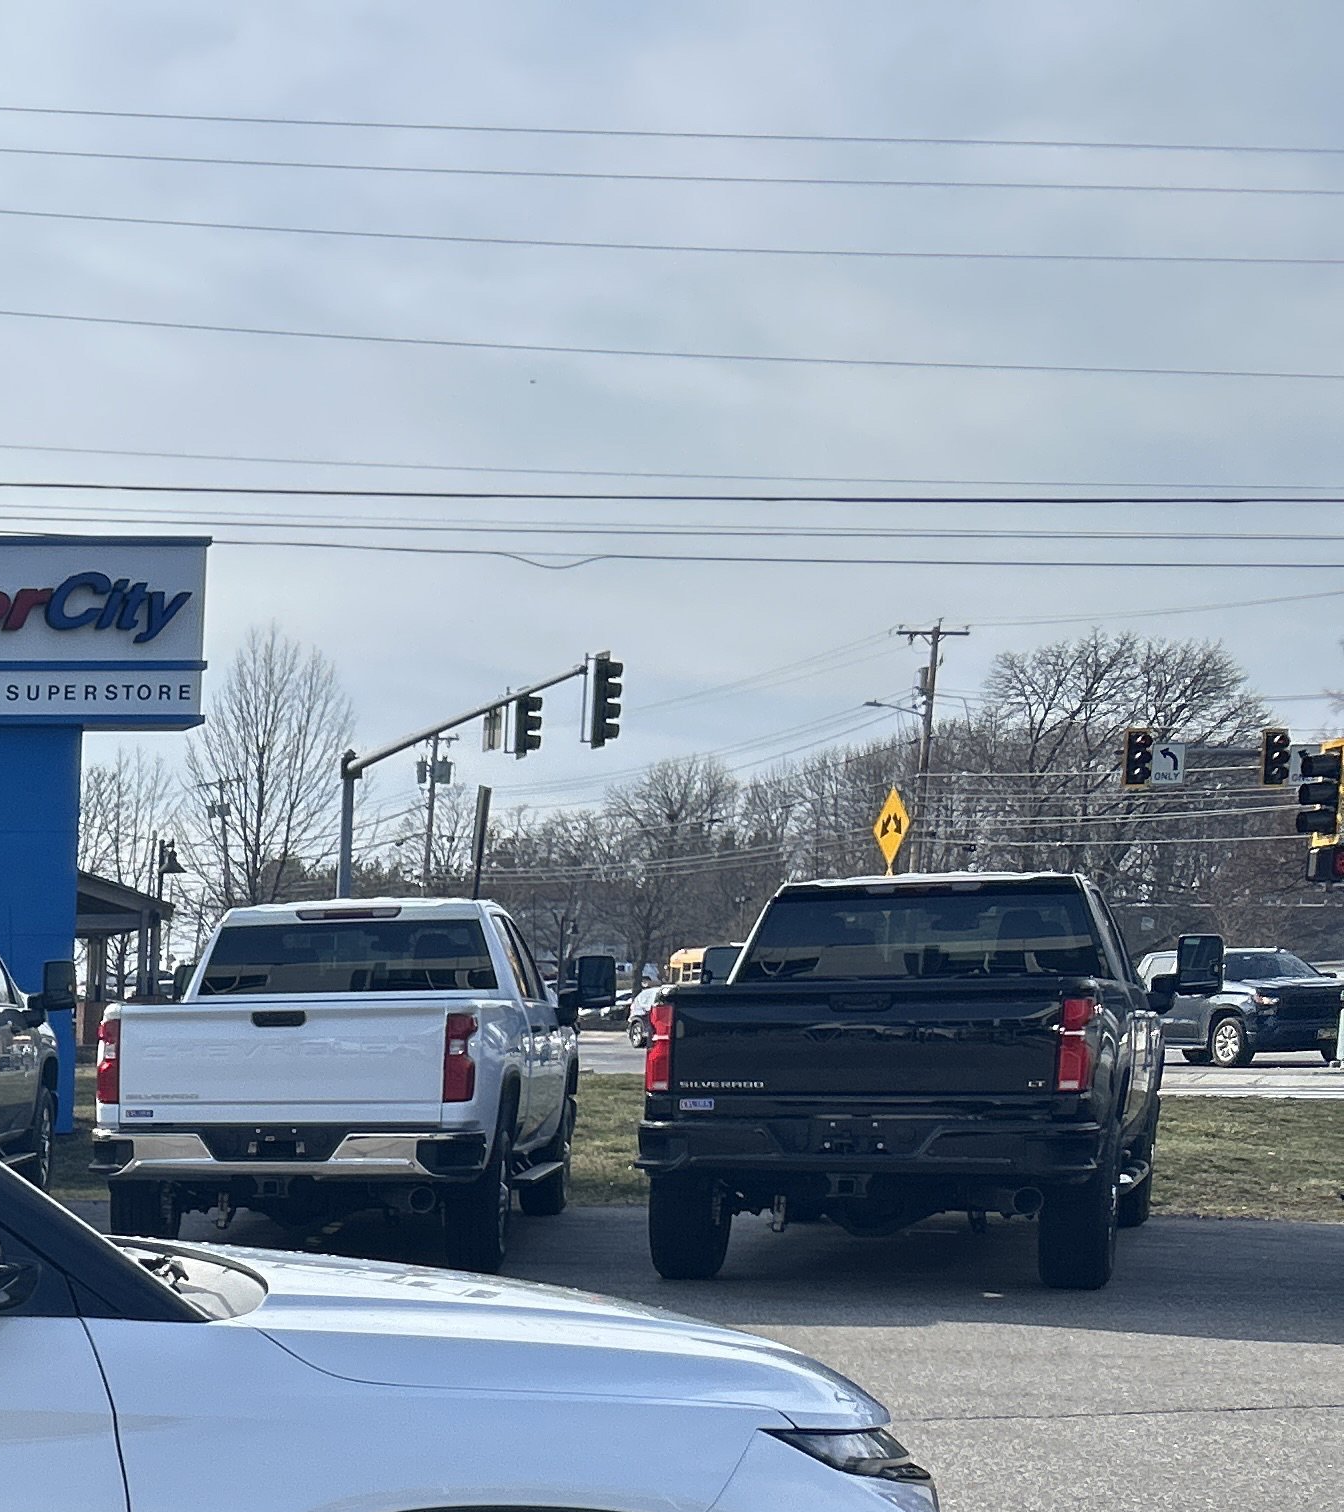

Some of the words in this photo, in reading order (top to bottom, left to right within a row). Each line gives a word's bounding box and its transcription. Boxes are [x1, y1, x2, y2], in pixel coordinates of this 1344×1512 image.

[6, 684, 192, 701] SUPERSTORE
[1154, 771, 1180, 781] ONLY
[679, 1081, 764, 1089] SILVERADO
